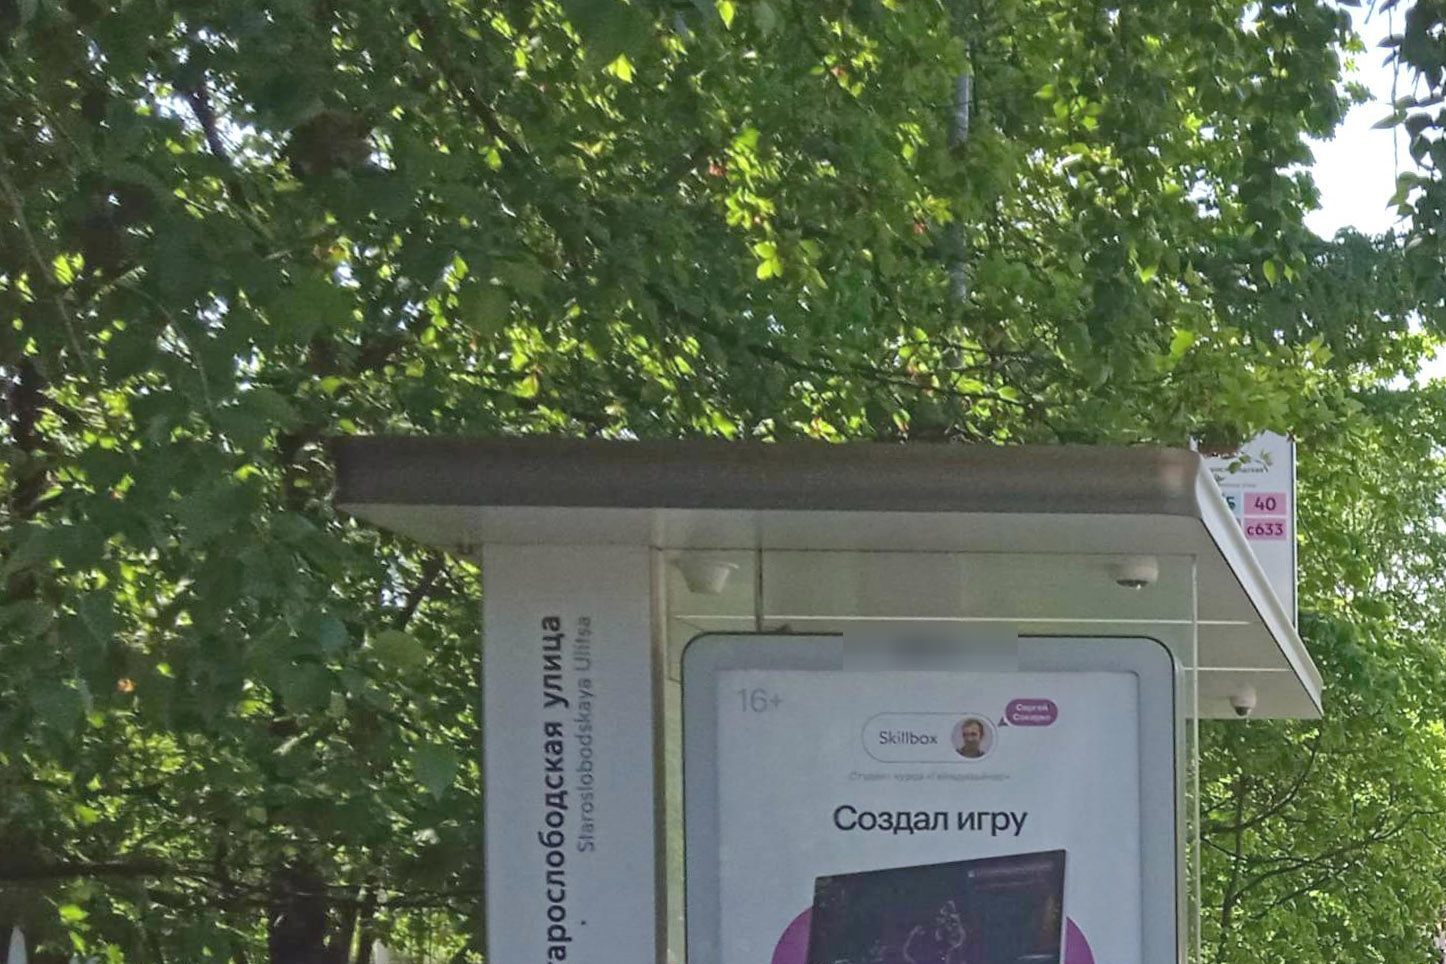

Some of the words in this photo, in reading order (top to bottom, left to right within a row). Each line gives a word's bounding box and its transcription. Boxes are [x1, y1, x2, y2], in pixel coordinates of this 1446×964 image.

[1255, 497, 1276, 511] 40
[542, 616, 569, 709] улица
[737, 687, 783, 714] 16+
[879, 731, 938, 745] Skillbox
[573, 678, 594, 853] Staroslobodskaya
[833, 805, 950, 834] Создал
[957, 811, 1028, 836] игру
